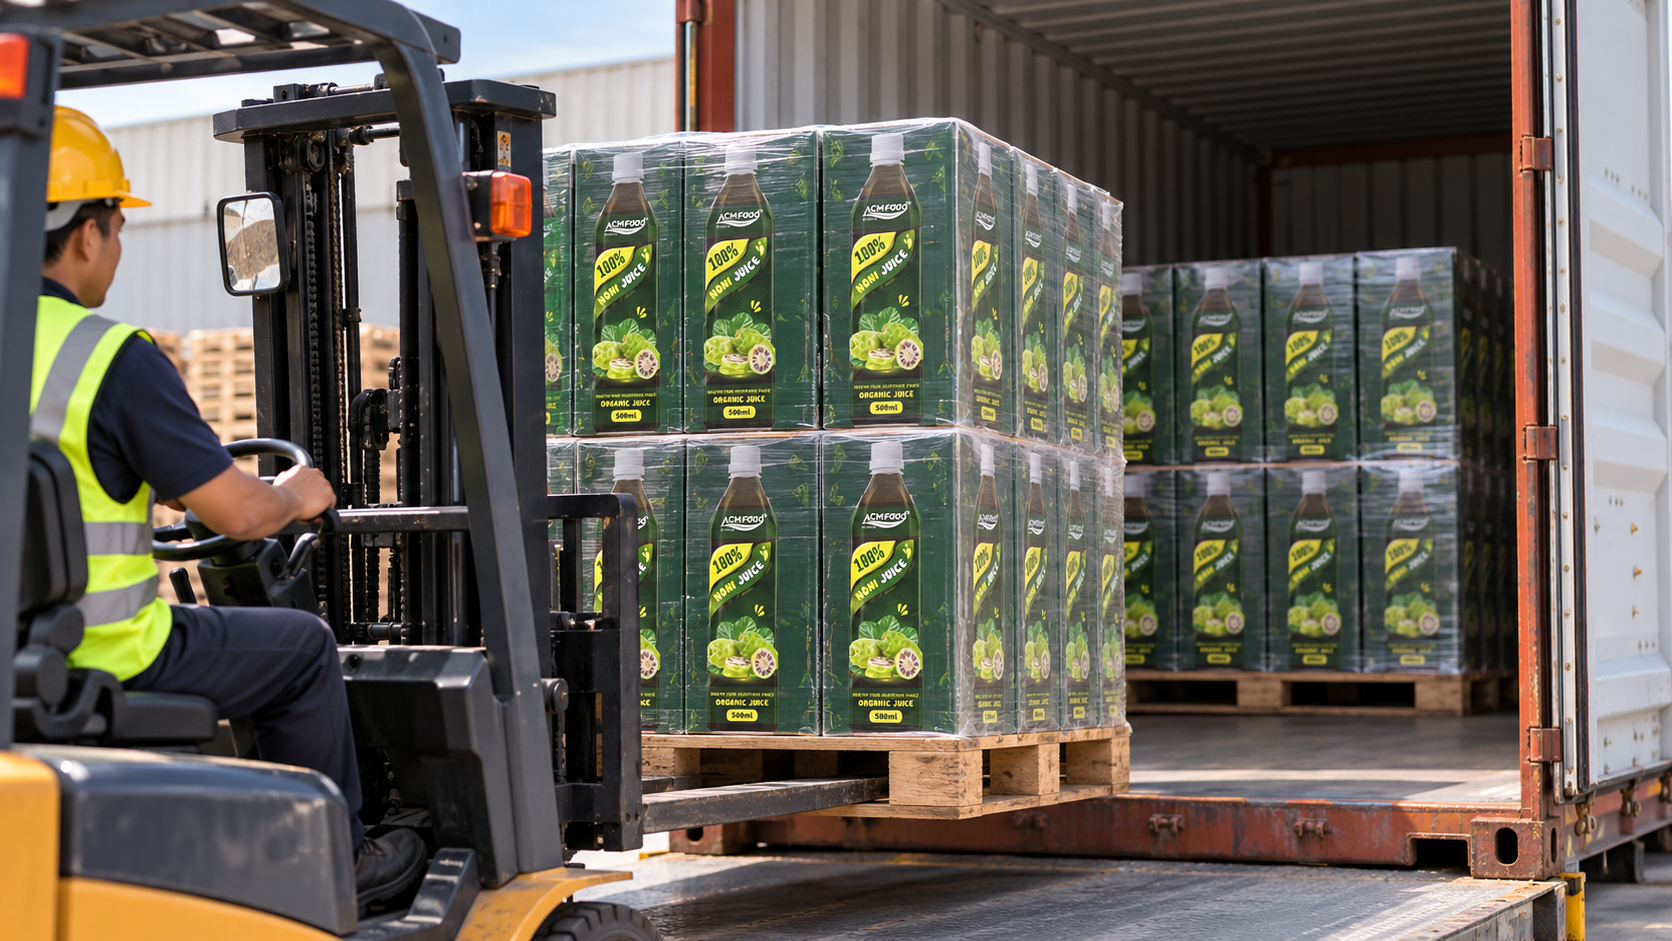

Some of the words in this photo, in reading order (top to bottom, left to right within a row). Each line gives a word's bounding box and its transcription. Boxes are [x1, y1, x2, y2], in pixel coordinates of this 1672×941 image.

[597, 250, 625, 278] 100%
[708, 242, 738, 271] 100%
[854, 235, 886, 265] 100%
[597, 284, 620, 305] NONI
[622, 263, 646, 288] JUICE
[709, 277, 733, 299] NONI
[734, 256, 760, 281] JUICE
[855, 270, 879, 293] NONI
[881, 249, 908, 276] JUICE
[1194, 336, 1216, 355] 100%
[1288, 335, 1311, 354] 100%
[1384, 330, 1408, 350] 100%
[893, 390, 914, 398] JUICE
[713, 546, 743, 574] 100%
[854, 544, 885, 572] 100%
[1196, 544, 1219, 562] 100%
[1291, 543, 1314, 562] 100%
[1388, 543, 1412, 561] 100%
[713, 580, 736, 602] NONI
[738, 560, 764, 585] JUICE
[855, 579, 879, 601] NONI
[880, 558, 907, 584] JUICE
